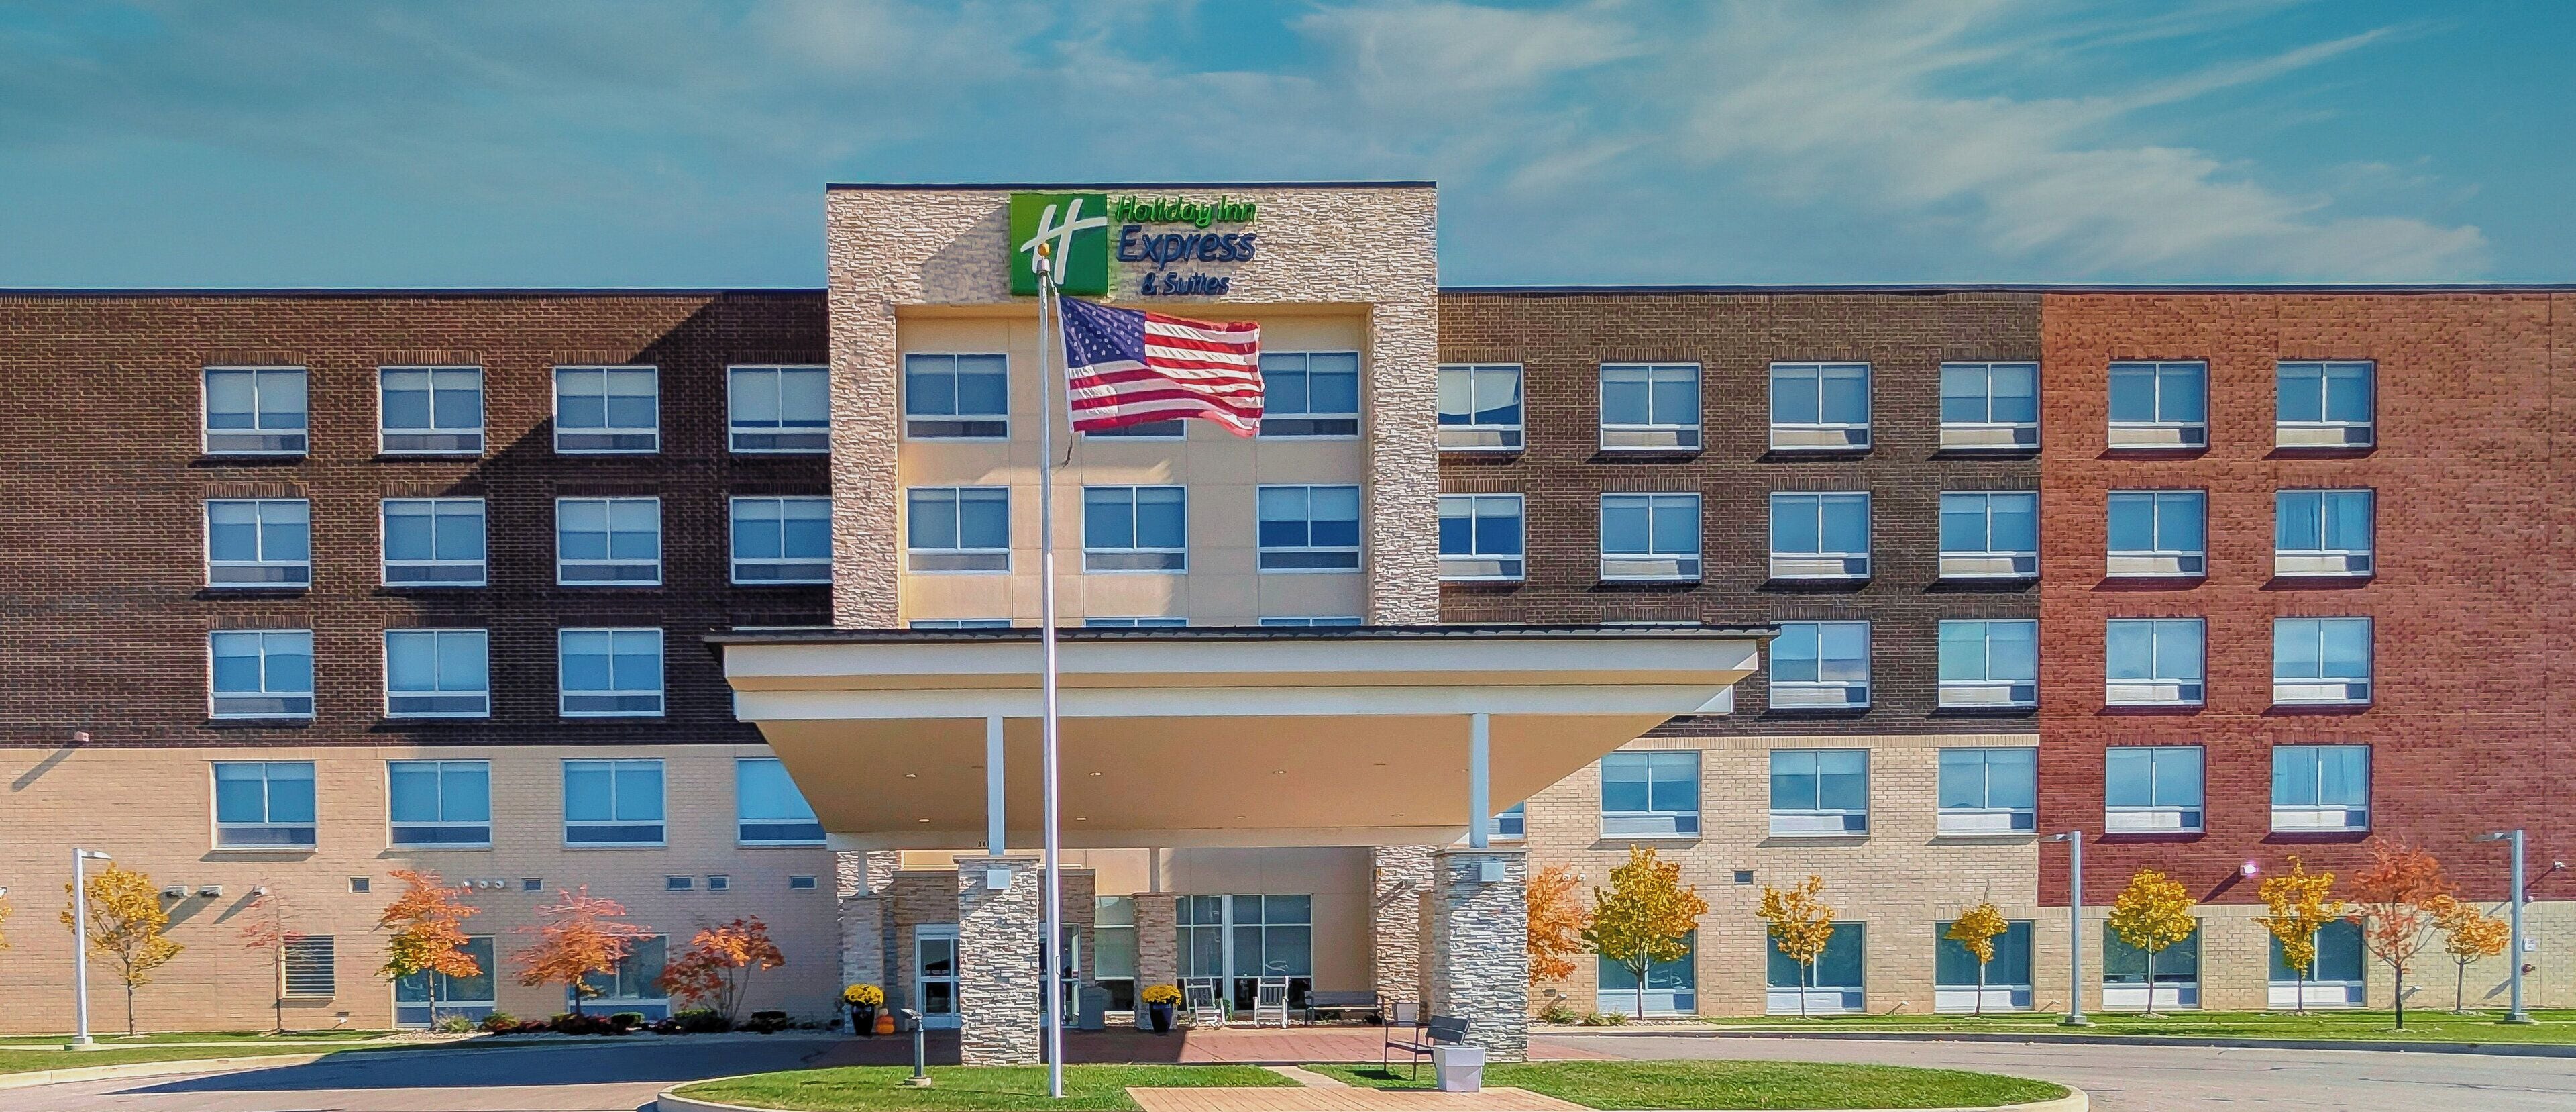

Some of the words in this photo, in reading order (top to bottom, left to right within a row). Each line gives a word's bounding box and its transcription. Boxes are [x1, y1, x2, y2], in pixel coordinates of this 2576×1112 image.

[1115, 195, 1213, 229] Holiday
[1217, 195, 1256, 223] Inn
[1116, 225, 1257, 271] Express
[1141, 272, 1158, 295] &
[1162, 272, 1230, 295] Suites
